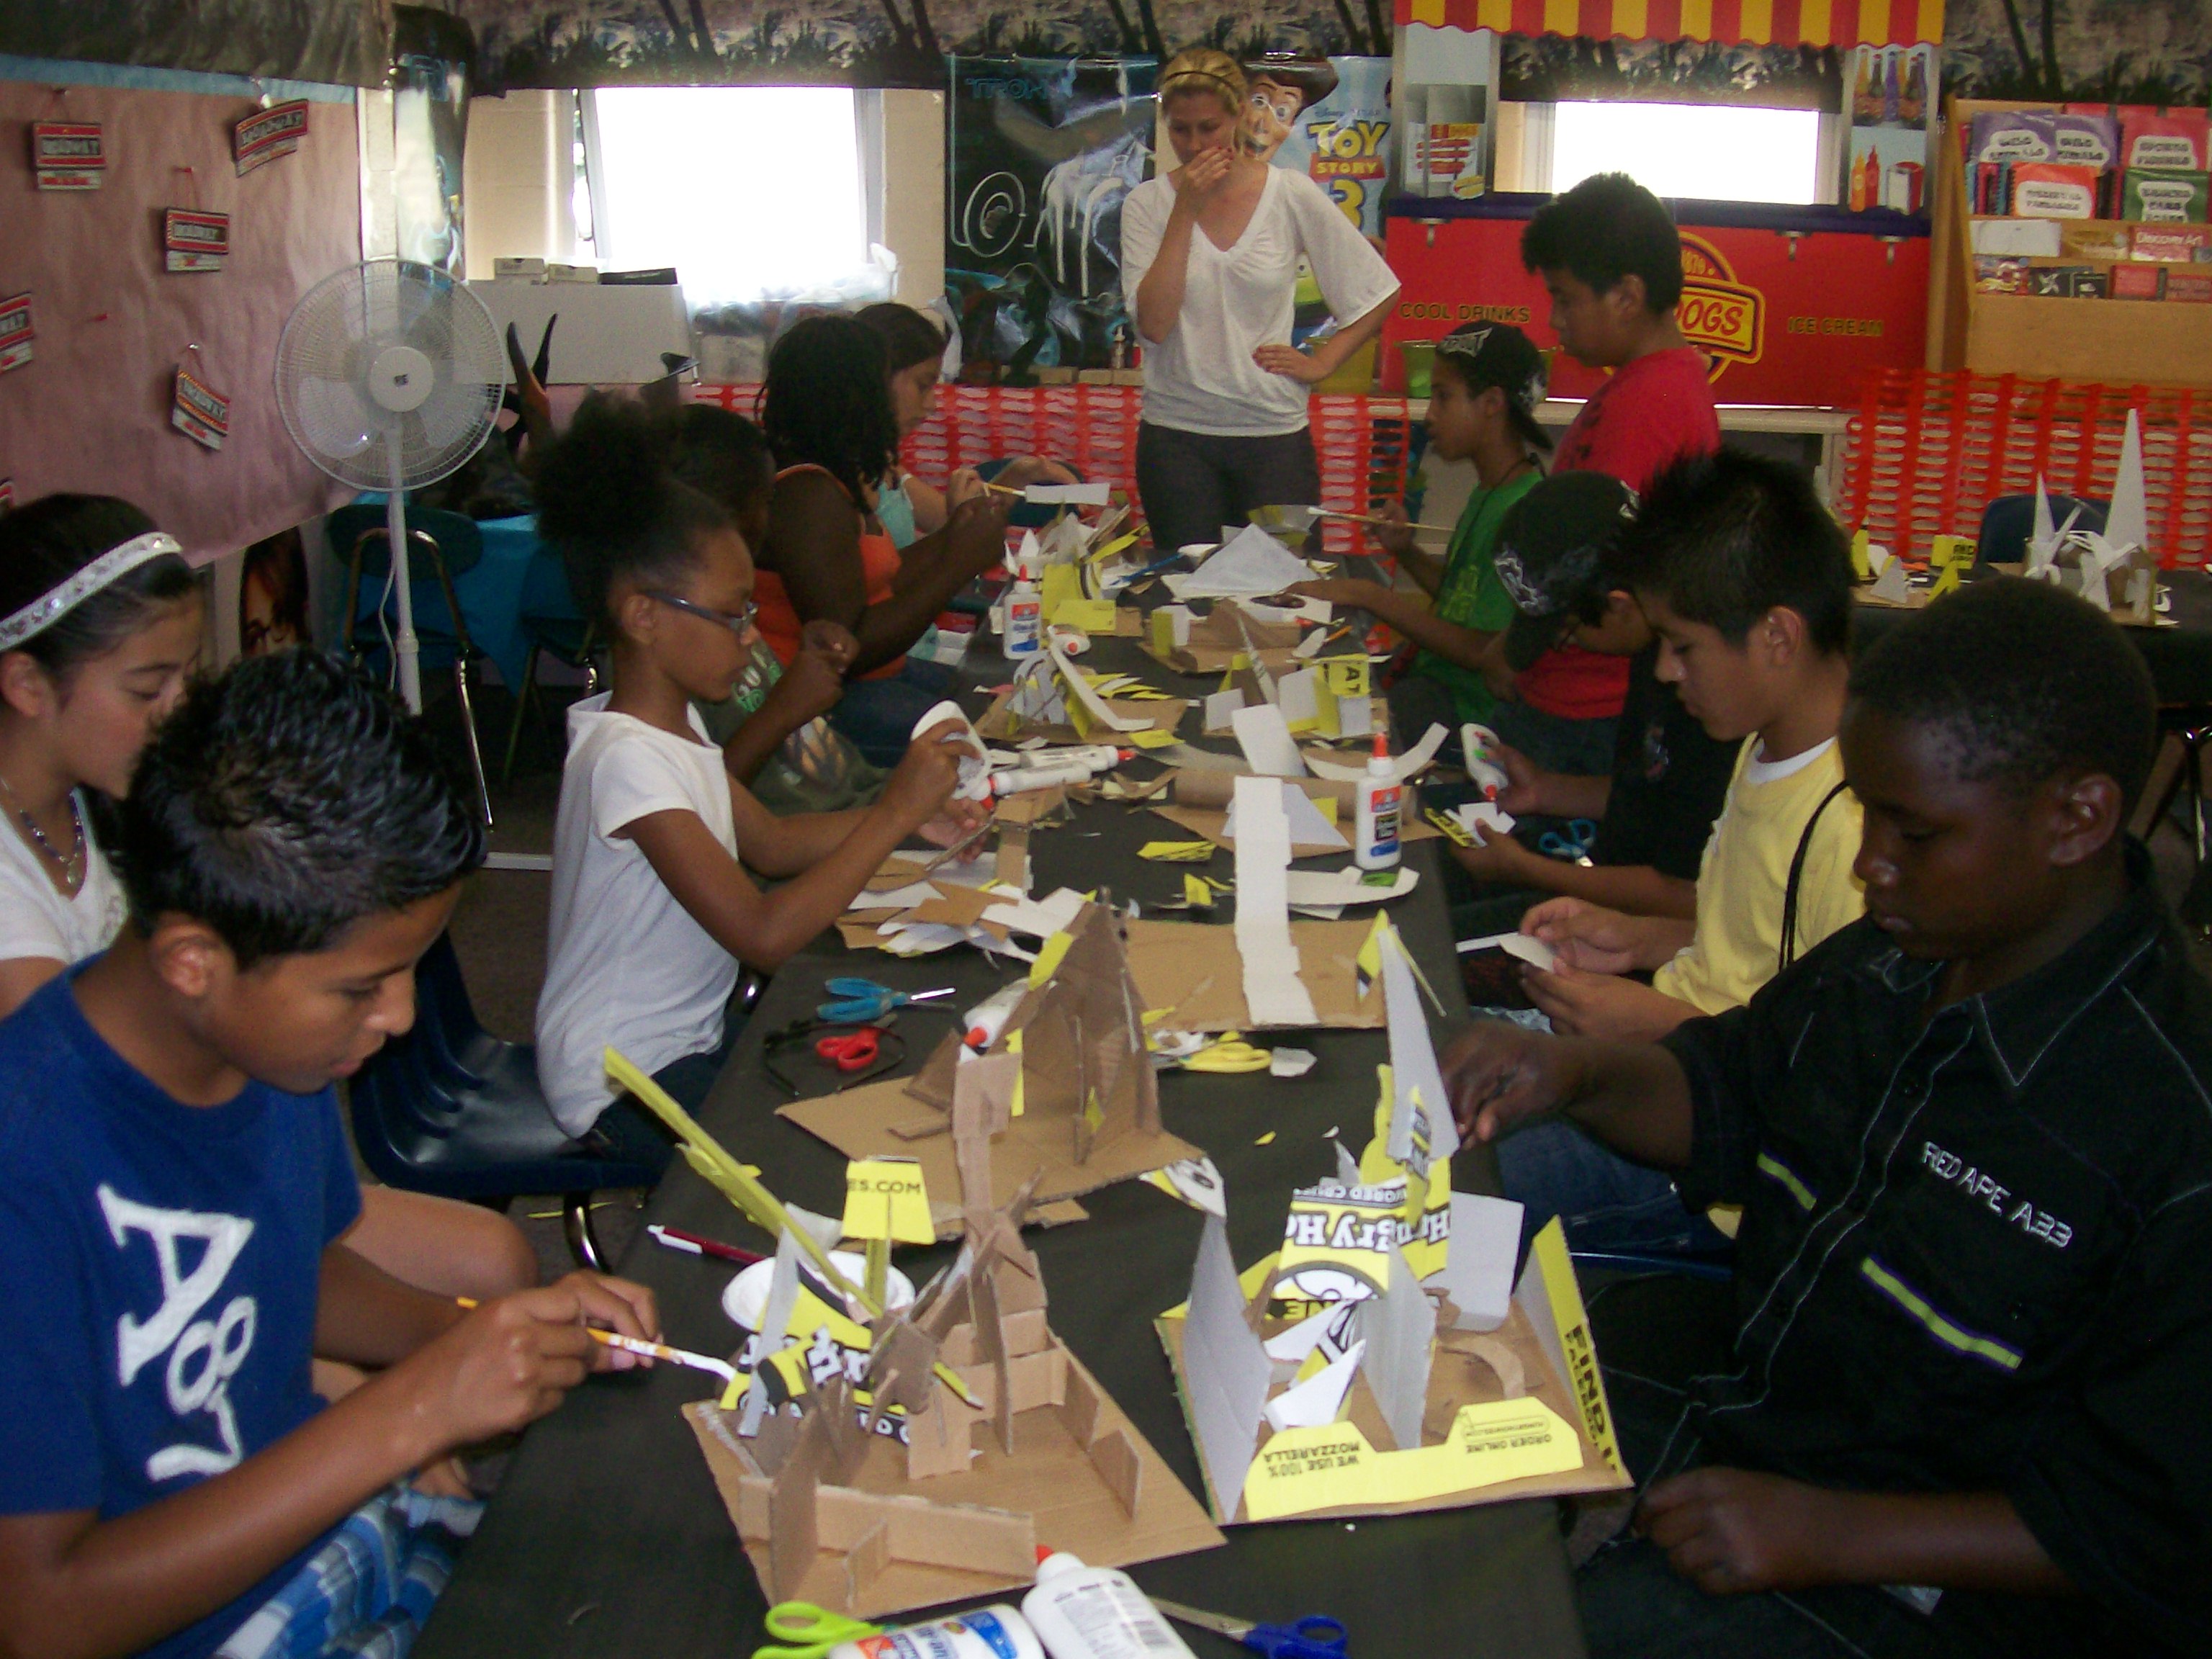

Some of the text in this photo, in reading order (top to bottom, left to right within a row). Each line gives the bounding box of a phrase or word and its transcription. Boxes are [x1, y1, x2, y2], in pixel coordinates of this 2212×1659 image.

[1307, 121, 1390, 158] TOY
[1316, 161, 1377, 175] STORY
[1330, 176, 1366, 231] 3
[1400, 302, 1531, 323] COOL DRINKS
[1789, 317, 1884, 337] ICE CREAM
[1922, 1141, 1963, 1180] RED
[1958, 1166, 2012, 1217] APE
[1264, 1441, 1359, 1463] MOZZARELLA
[1466, 1434, 1552, 1453] ORDER ONLINE
[1267, 1455, 1359, 1478] WE USE 100%
